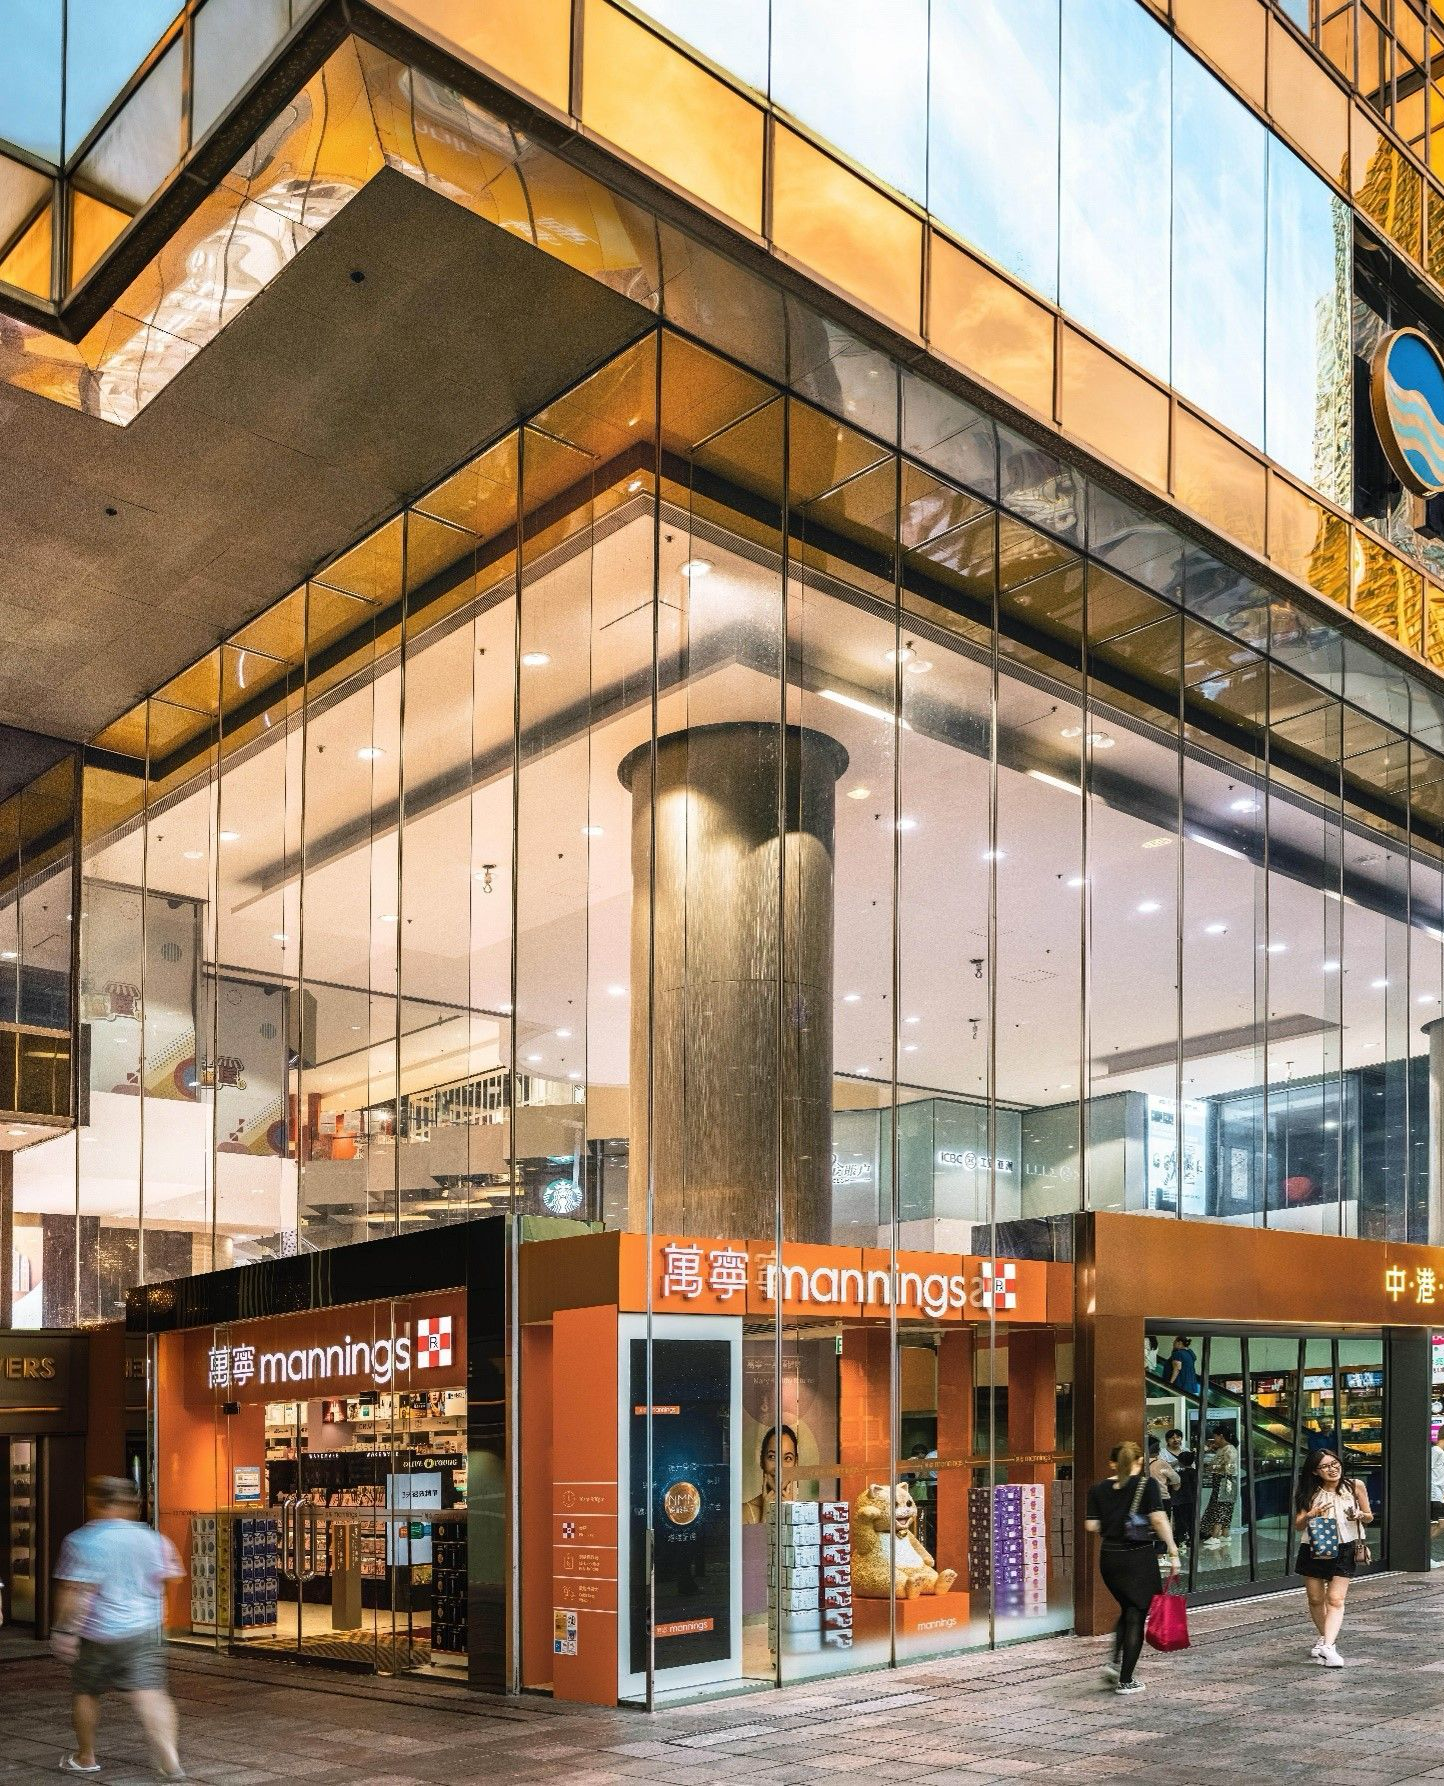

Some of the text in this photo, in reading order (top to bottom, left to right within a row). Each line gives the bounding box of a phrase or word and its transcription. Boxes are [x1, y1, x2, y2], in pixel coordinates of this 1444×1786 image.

[941, 1151, 963, 1165] ICBC
[660, 1242, 967, 1318] 萬寧 mannings
[0, 1357, 56, 1379] ERS
[208, 1335, 411, 1390] 萬寧 mannings
[669, 1620, 708, 1633] mannings
[917, 1616, 957, 1631] mannings
